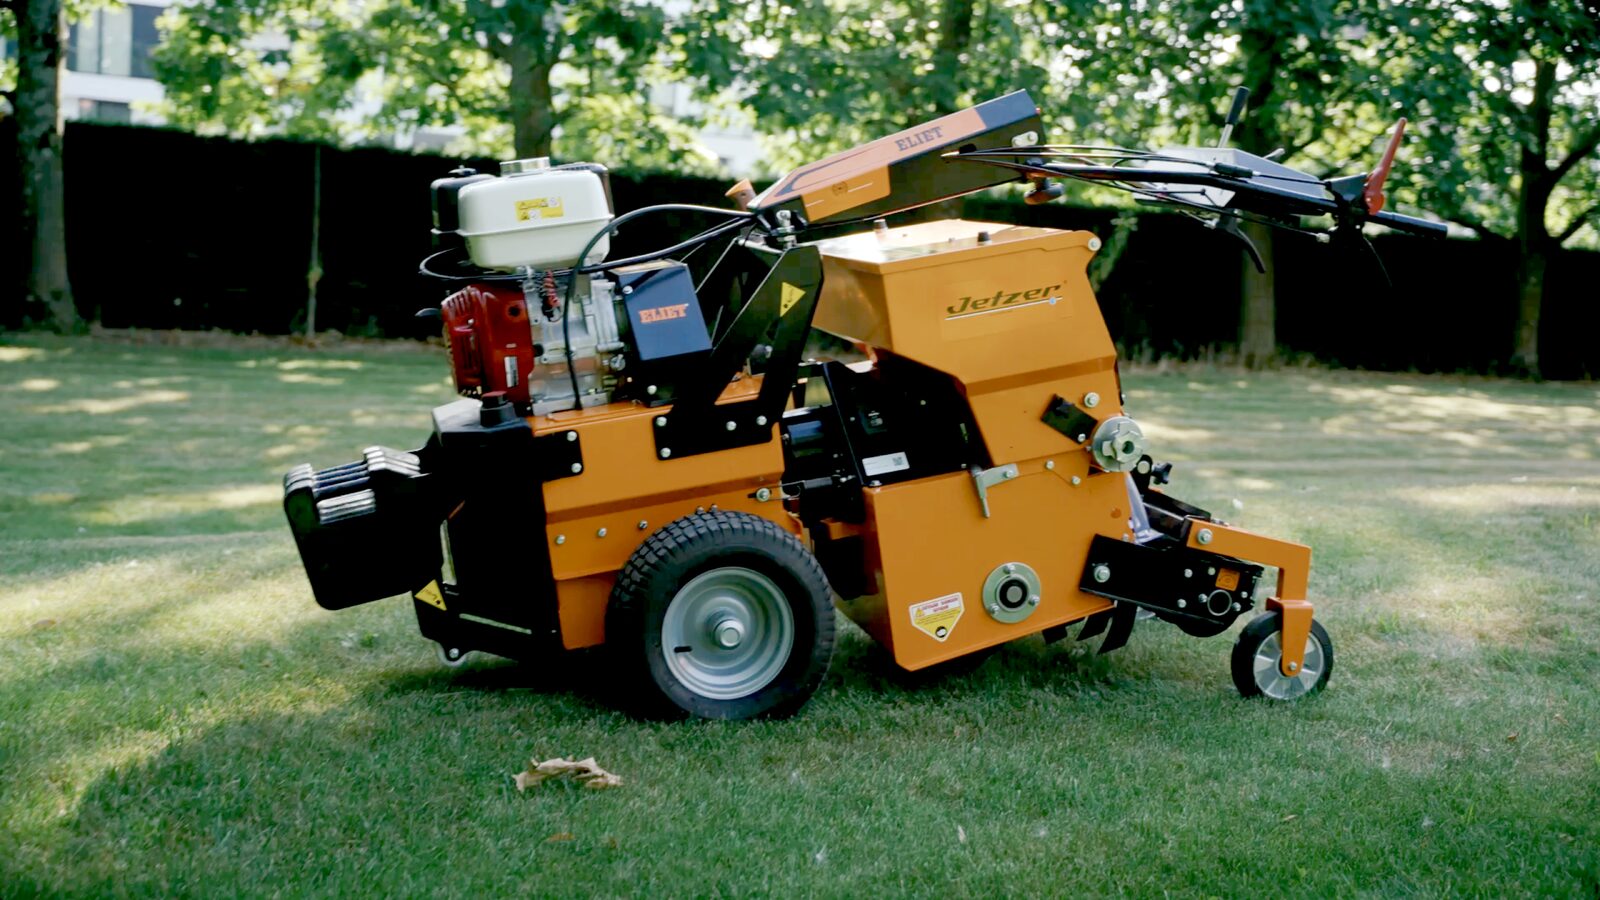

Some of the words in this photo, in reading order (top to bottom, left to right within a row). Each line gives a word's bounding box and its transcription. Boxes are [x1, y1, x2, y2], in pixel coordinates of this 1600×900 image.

[895, 126, 943, 151] ELIET
[947, 284, 1062, 314] Jetzer
[639, 304, 687, 323] ELIET
